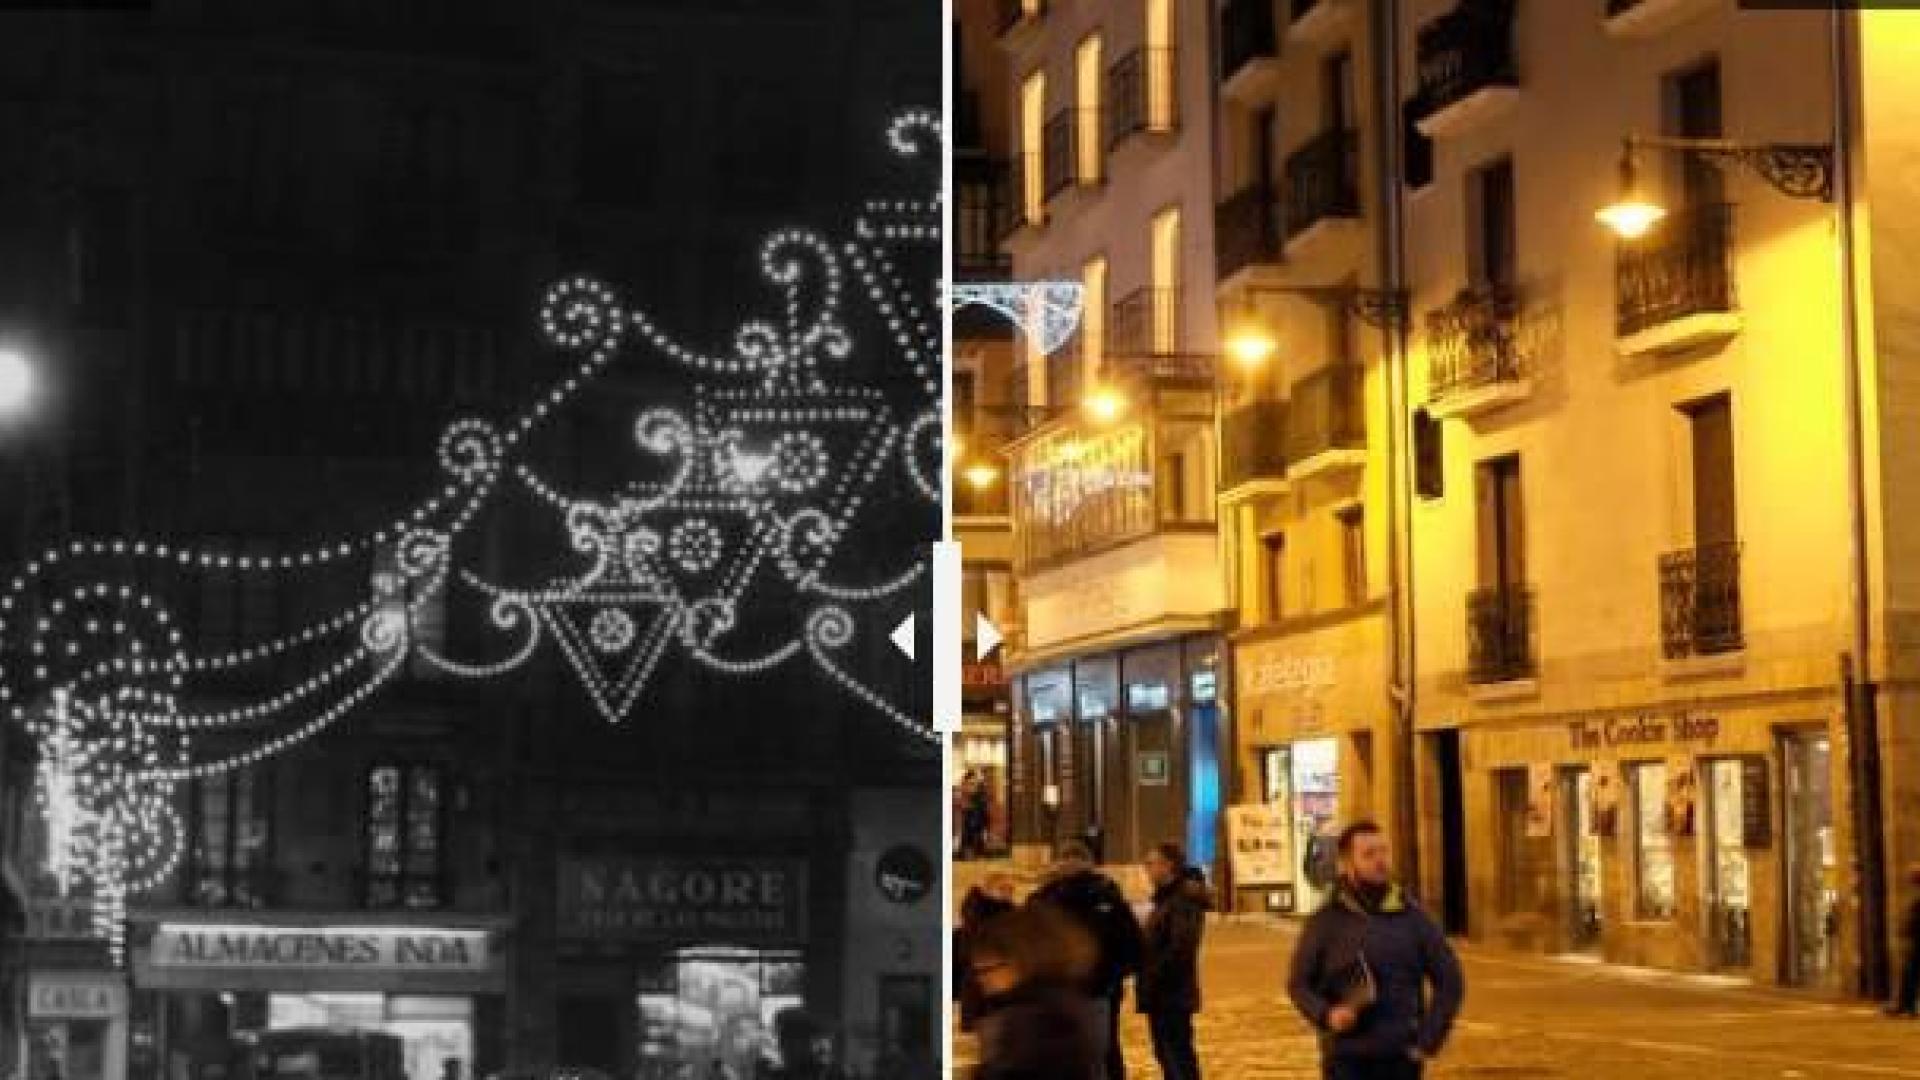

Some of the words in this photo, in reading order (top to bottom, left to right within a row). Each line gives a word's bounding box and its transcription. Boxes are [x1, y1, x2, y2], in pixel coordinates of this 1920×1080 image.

[1567, 721, 1600, 749] The
[1603, 713, 1665, 747] Cookie
[1672, 709, 1719, 748] Shop
[580, 867, 785, 905] NAGORE
[174, 933, 381, 964] ALMACENES
[394, 935, 468, 964] INDA
